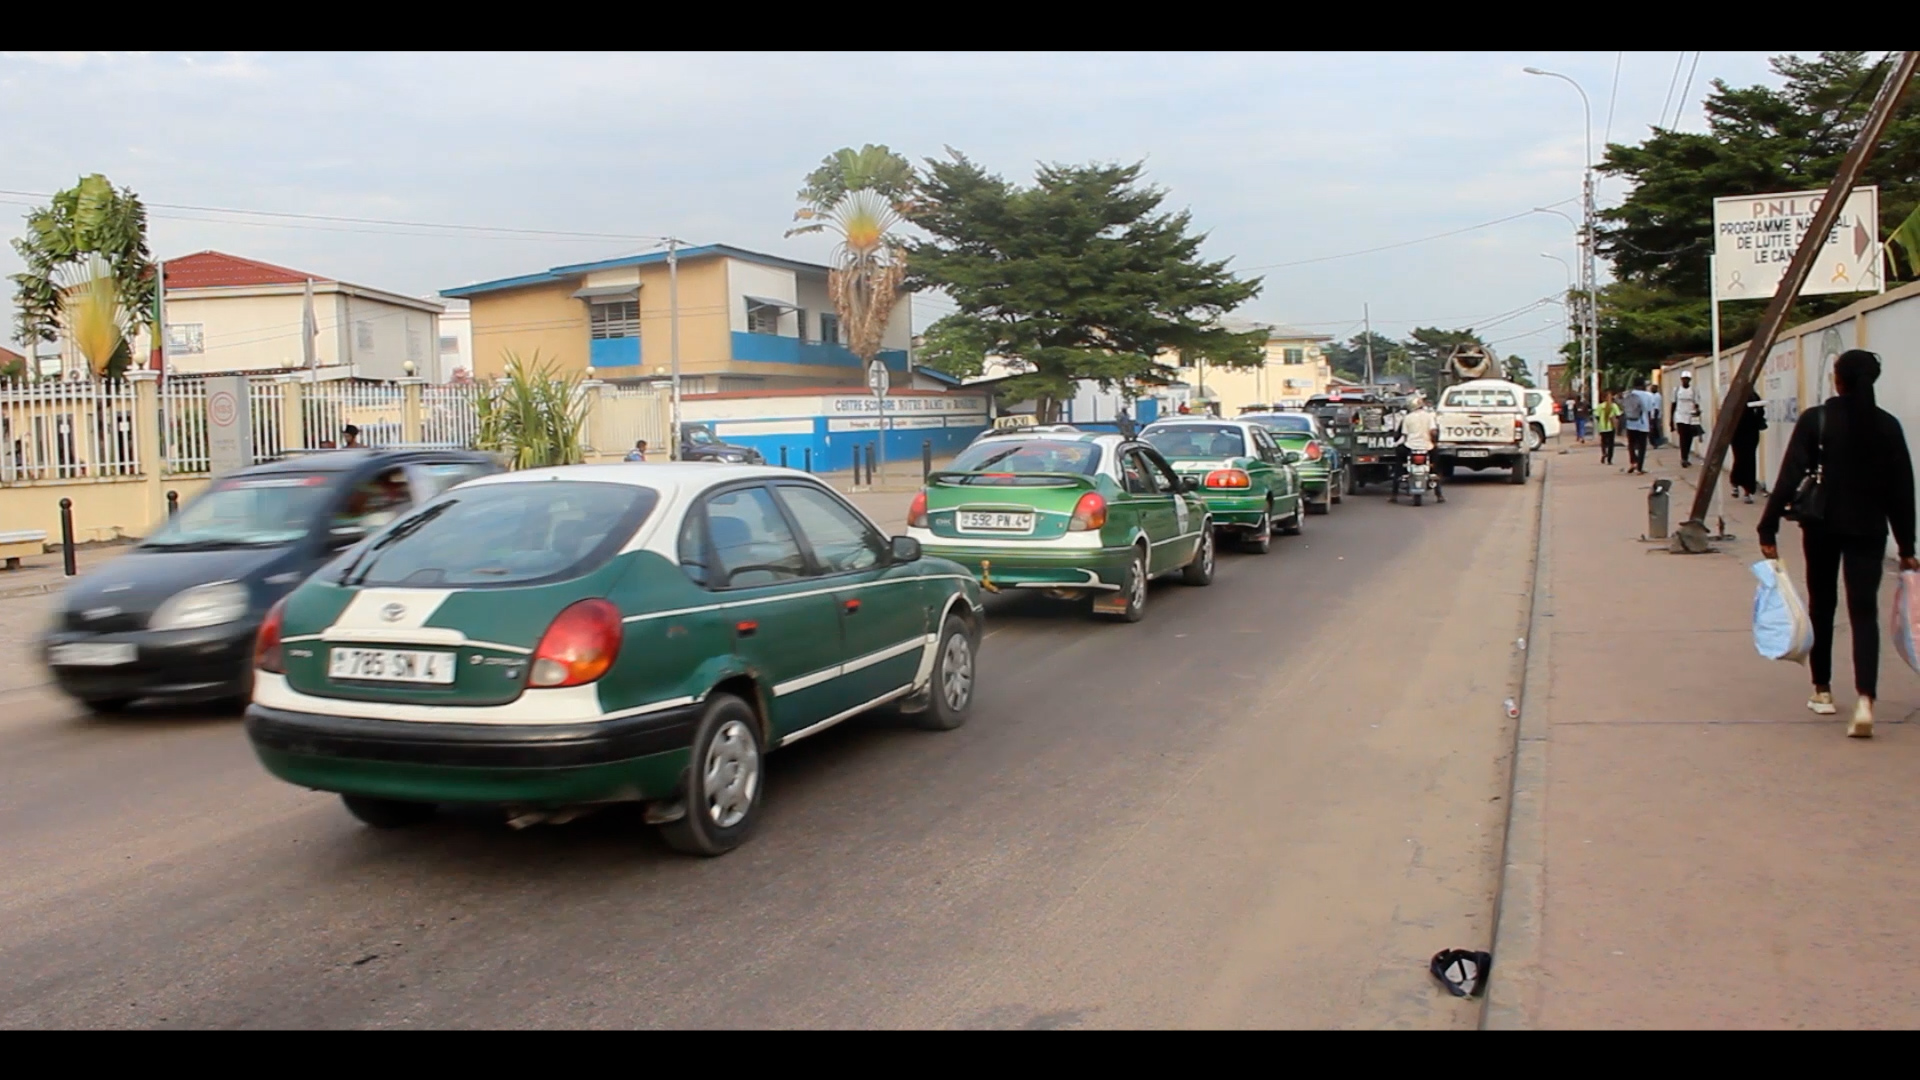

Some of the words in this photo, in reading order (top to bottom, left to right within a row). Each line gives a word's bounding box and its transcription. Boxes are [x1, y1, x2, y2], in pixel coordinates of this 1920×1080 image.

[1720, 218, 1791, 236] PROGRAMME
[1796, 215, 1850, 231] NAAL
[1737, 236, 1752, 250] DE
[1756, 234, 1791, 249] LUTTE
[1755, 249, 1768, 264] LE
[835, 399, 863, 411] CENTRE
[864, 399, 896, 411] SCOAIRE
[997, 416, 1028, 429] TAXI
[1446, 426, 1500, 438] TOYOTA
[971, 513, 993, 527] 592
[996, 514, 1010, 527] PN
[349, 651, 385, 675] 785
[391, 653, 417, 677] SN
[423, 654, 436, 677] 4
